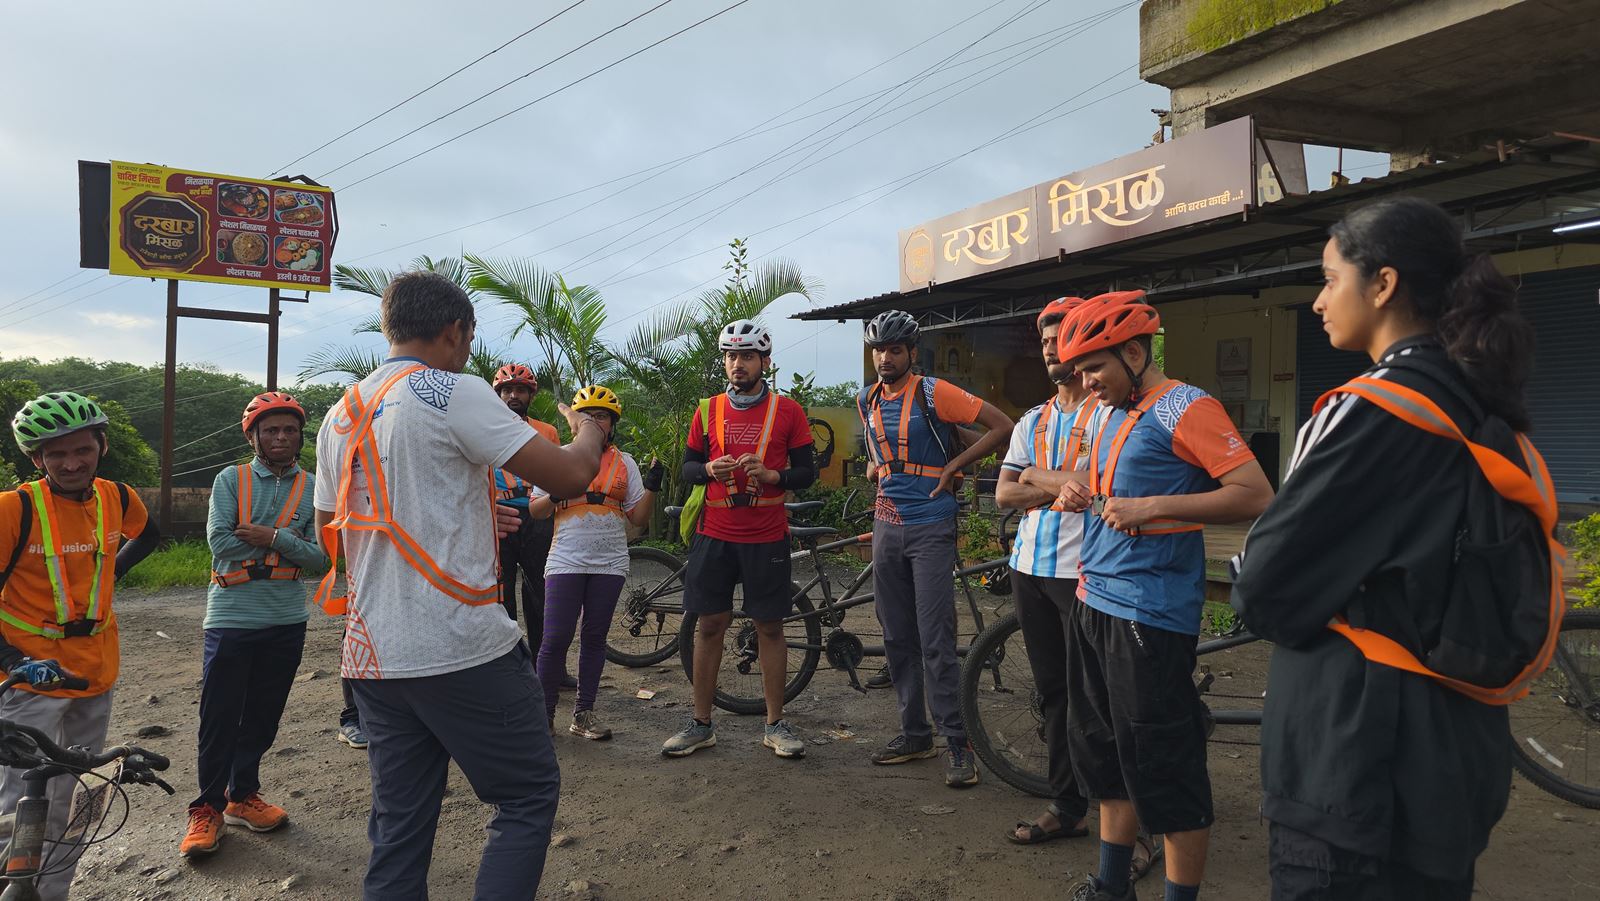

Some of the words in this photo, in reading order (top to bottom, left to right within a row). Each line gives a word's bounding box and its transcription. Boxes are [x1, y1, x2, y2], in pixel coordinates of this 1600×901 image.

[1048, 164, 1166, 234] मिसळ
[1165, 202, 1187, 217] आणि
[1208, 190, 1231, 205] काही
[133, 214, 196, 237] दरबार
[942, 207, 1030, 266] दरबार
[146, 233, 184, 250] मिसळ
[29, 542, 93, 554] #inusion
